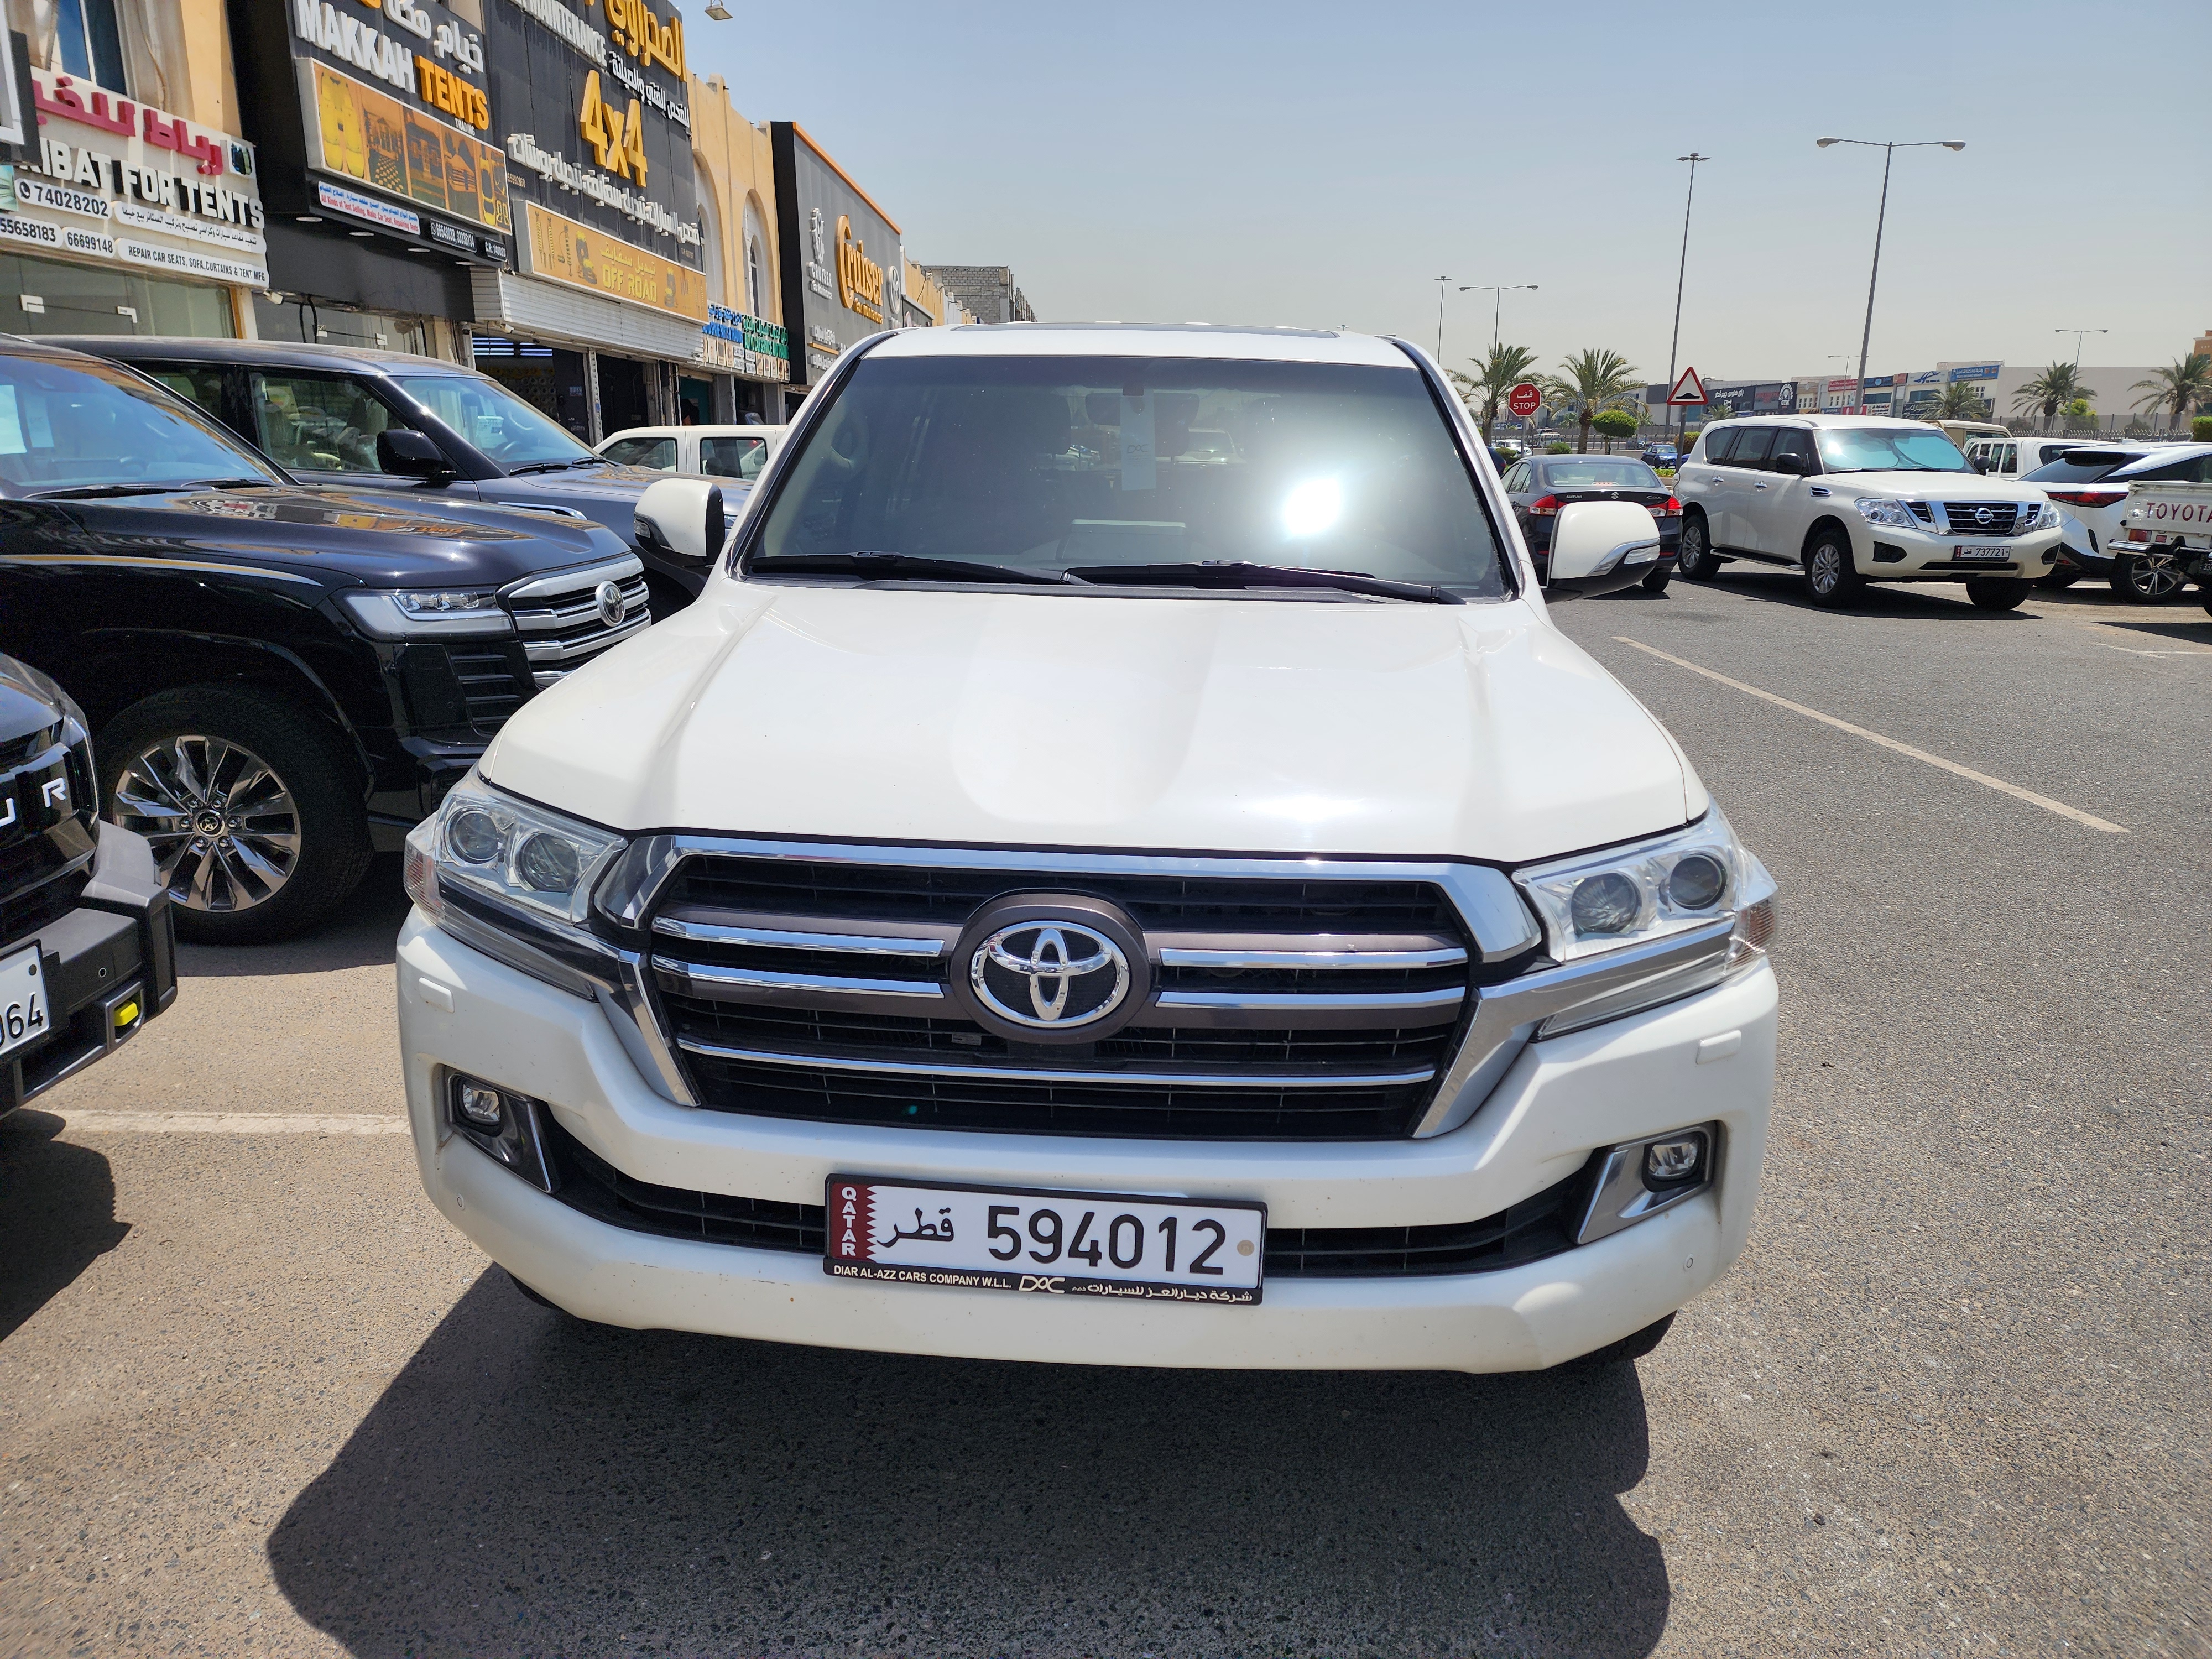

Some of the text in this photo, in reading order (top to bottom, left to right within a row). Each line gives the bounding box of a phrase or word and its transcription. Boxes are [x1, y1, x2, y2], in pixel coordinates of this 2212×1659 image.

[295, 0, 489, 130] MAKKAH TENTS
[434, 20, 483, 74] خيام
[32, 76, 223, 175] رباط للخي
[20, 137, 265, 229] IBAT FOR TENTS
[34, 185, 109, 217] 74028202
[0, 217, 56, 242] 55658183
[128, 246, 152, 260] REPAIR
[153, 251, 166, 263] CAR
[168, 254, 188, 268] SEATS,
[239, 268, 252, 279] TENT
[253, 270, 265, 281] MFG
[602, 264, 658, 302] OFF ROAD
[1517, 389, 1533, 398] قف
[1975, 548, 2005, 556] 737721
[0, 993, 43, 1047] 64
[842, 1187, 857, 1256] QATAR
[877, 1207, 954, 1248] قطر
[988, 1206, 1226, 1275] 594012
[834, 1265, 1011, 1288] DIAR AL-AZZ CARS COMPANY W.L.L.
[1087, 1284, 1144, 1295] للسيارات
[1209, 1291, 1253, 1303] شركة
